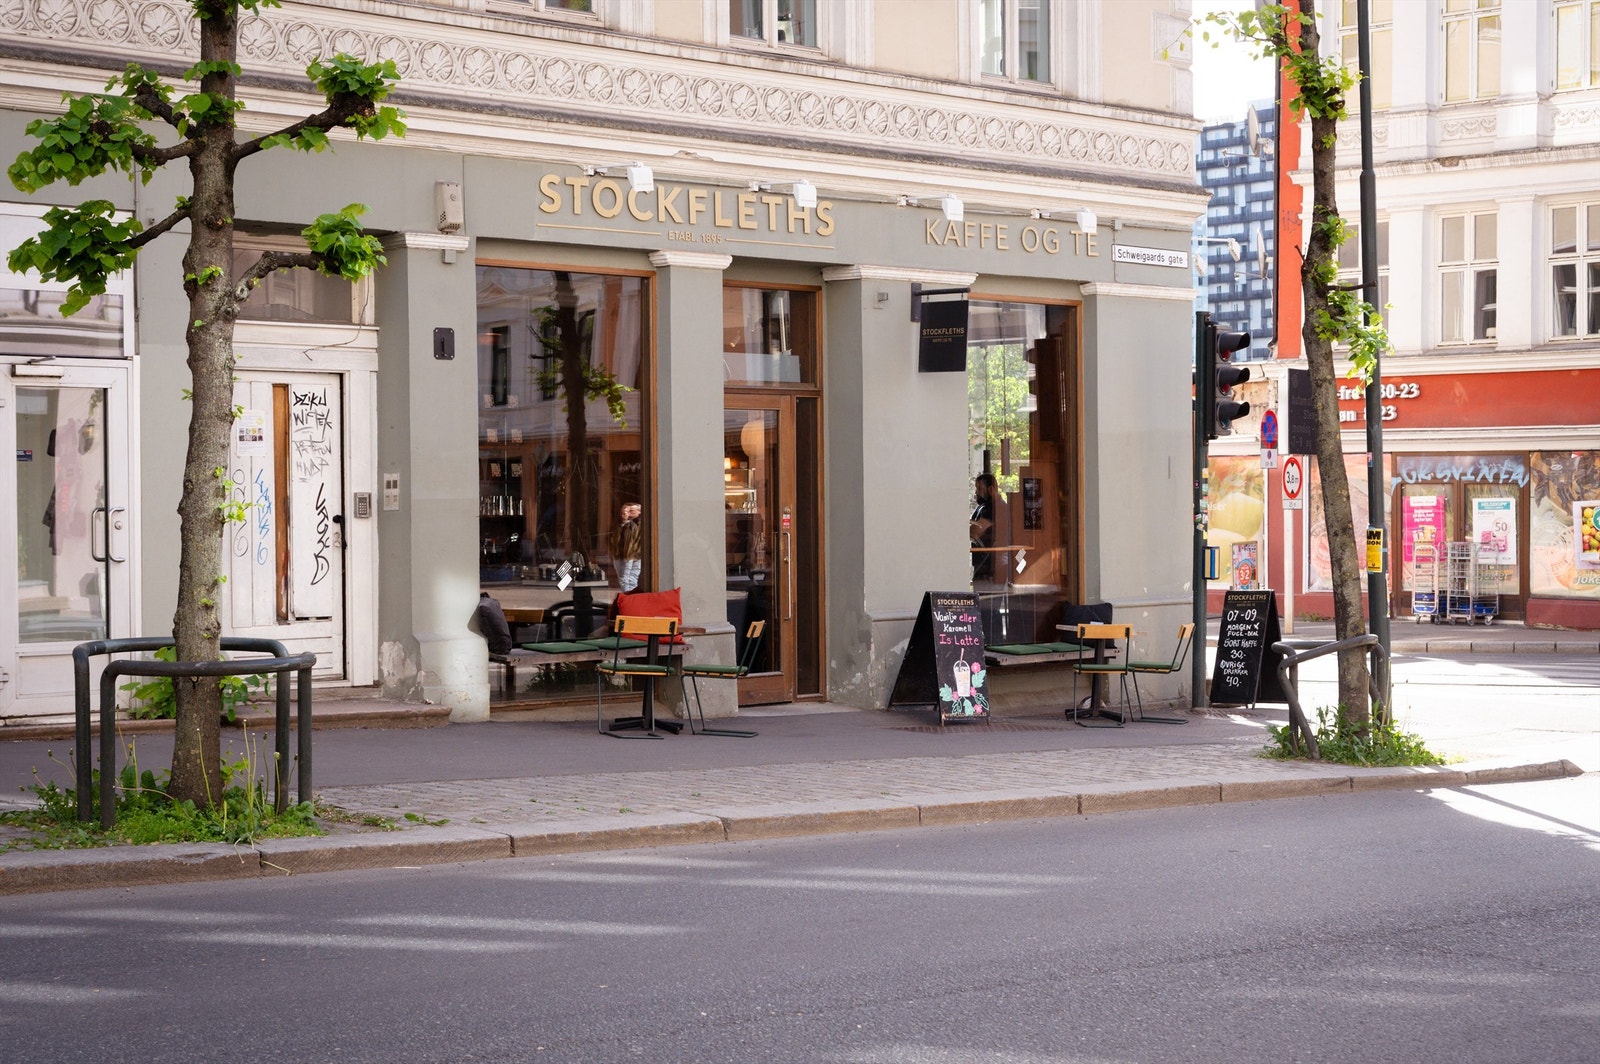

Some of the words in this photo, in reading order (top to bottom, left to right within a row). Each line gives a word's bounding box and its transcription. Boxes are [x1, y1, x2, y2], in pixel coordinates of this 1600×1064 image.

[538, 174, 836, 237] STOCKFLETHS
[701, 233, 723, 244] 1895
[926, 218, 1009, 250] KAFFE
[1021, 226, 1060, 255] OG
[1070, 230, 1100, 257] TE
[1117, 248, 1166, 263] Schweigaards
[1168, 255, 1184, 266] gate
[922, 327, 965, 336] STOCKFLETHS
[1495, 522, 1508, 532] 50
[959, 613, 977, 623] eller
[943, 624, 972, 633] Karamell
[939, 634, 952, 645] Is
[954, 635, 980, 646] Latte
[1223, 638, 1240, 647] SORT
